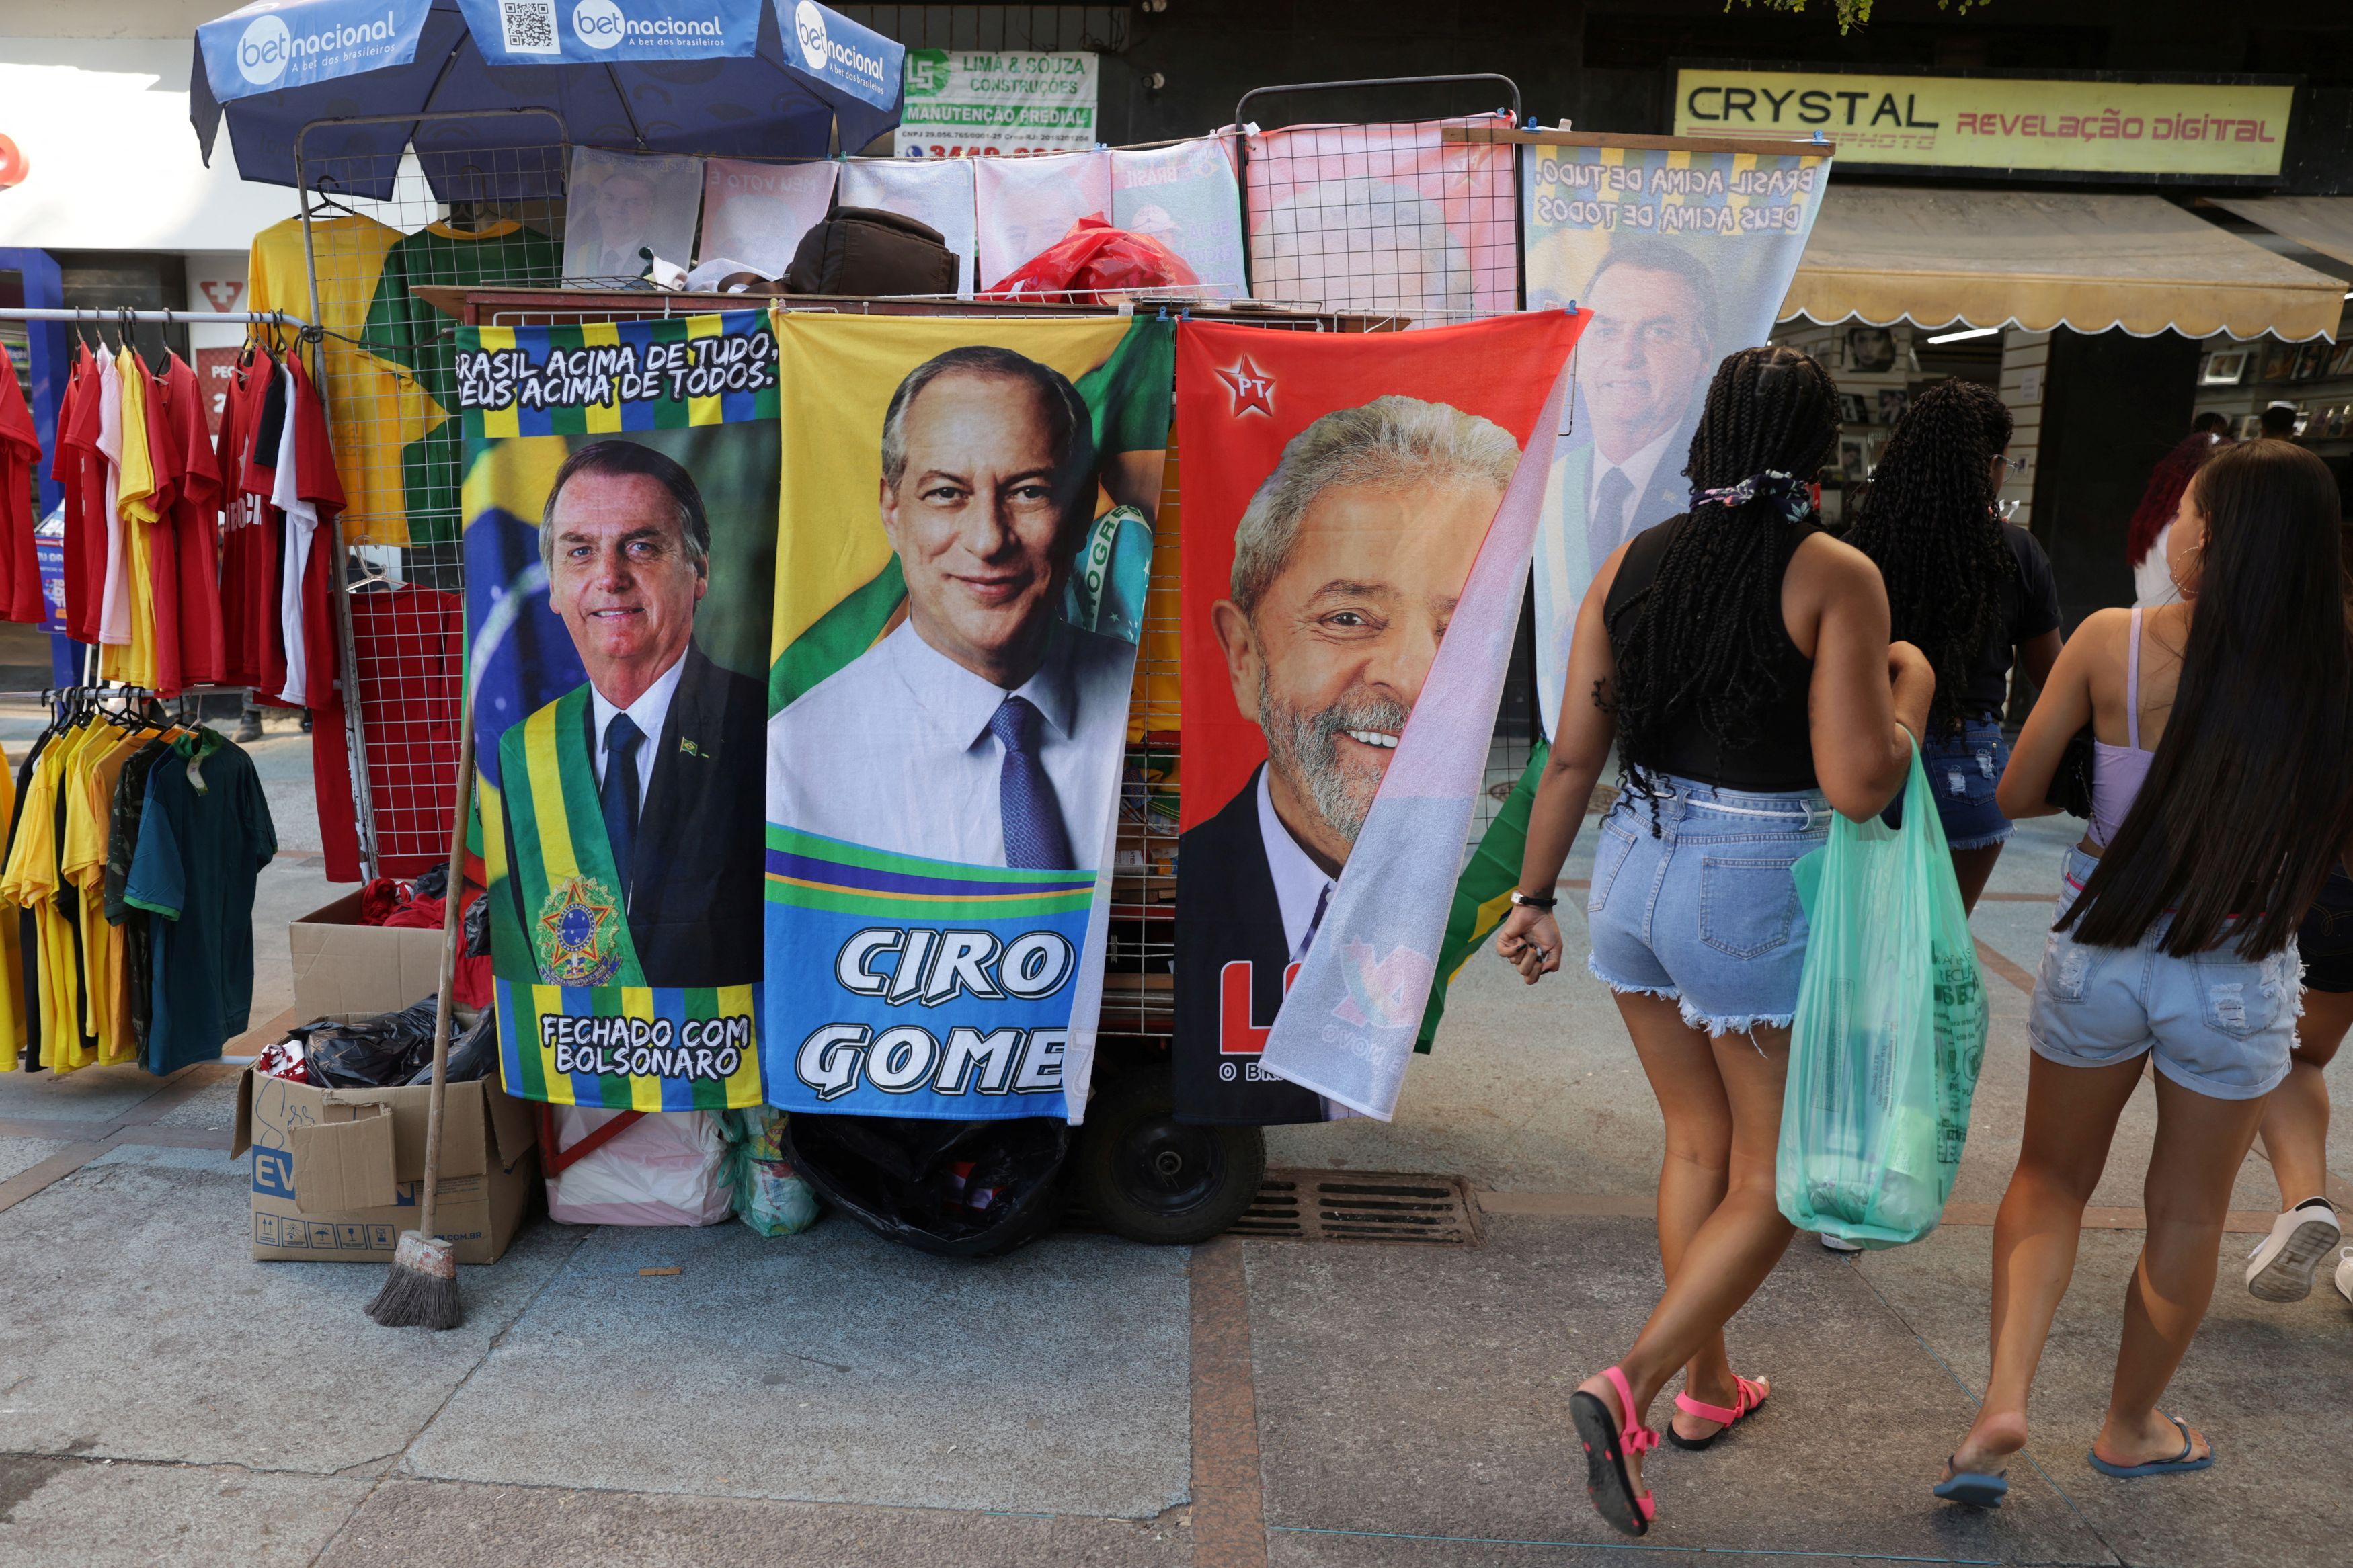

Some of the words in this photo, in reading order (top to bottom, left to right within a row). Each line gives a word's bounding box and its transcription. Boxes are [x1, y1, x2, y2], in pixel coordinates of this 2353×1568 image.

[639, 38, 653, 46] bet
[657, 38, 674, 46] dos
[677, 37, 725, 46] brasileiros
[292, 63, 298, 73] A
[303, 60, 317, 71] bet
[322, 56, 339, 66] dos
[343, 43, 395, 62] brasileiros
[963, 56, 1004, 72] LIMA
[1008, 56, 1021, 73] &
[1026, 57, 1086, 75] SOUZA
[830, 63, 834, 72] A
[834, 65, 844, 77] bet
[845, 71, 856, 82] dos
[857, 74, 884, 95] brasileiros
[970, 78, 1078, 95] CONSTRUÇÕES
[908, 104, 1014, 125] MANUTENÇÃO
[1019, 108, 1085, 124] PREDIAL
[1688, 87, 1939, 128] CRYSTAL
[547, 346, 637, 378] ACIMA
[647, 343, 686, 370] DE
[692, 333, 779, 364] TUDO,
[521, 373, 612, 409] ACIMA
[622, 370, 660, 398] DE
[1237, 377, 1266, 399] PT
[835, 926, 1076, 1008] CIRO
[542, 1016, 672, 1049] FECHADO
[682, 1017, 749, 1050] COM
[557, 1044, 739, 1080] BOLSONARO
